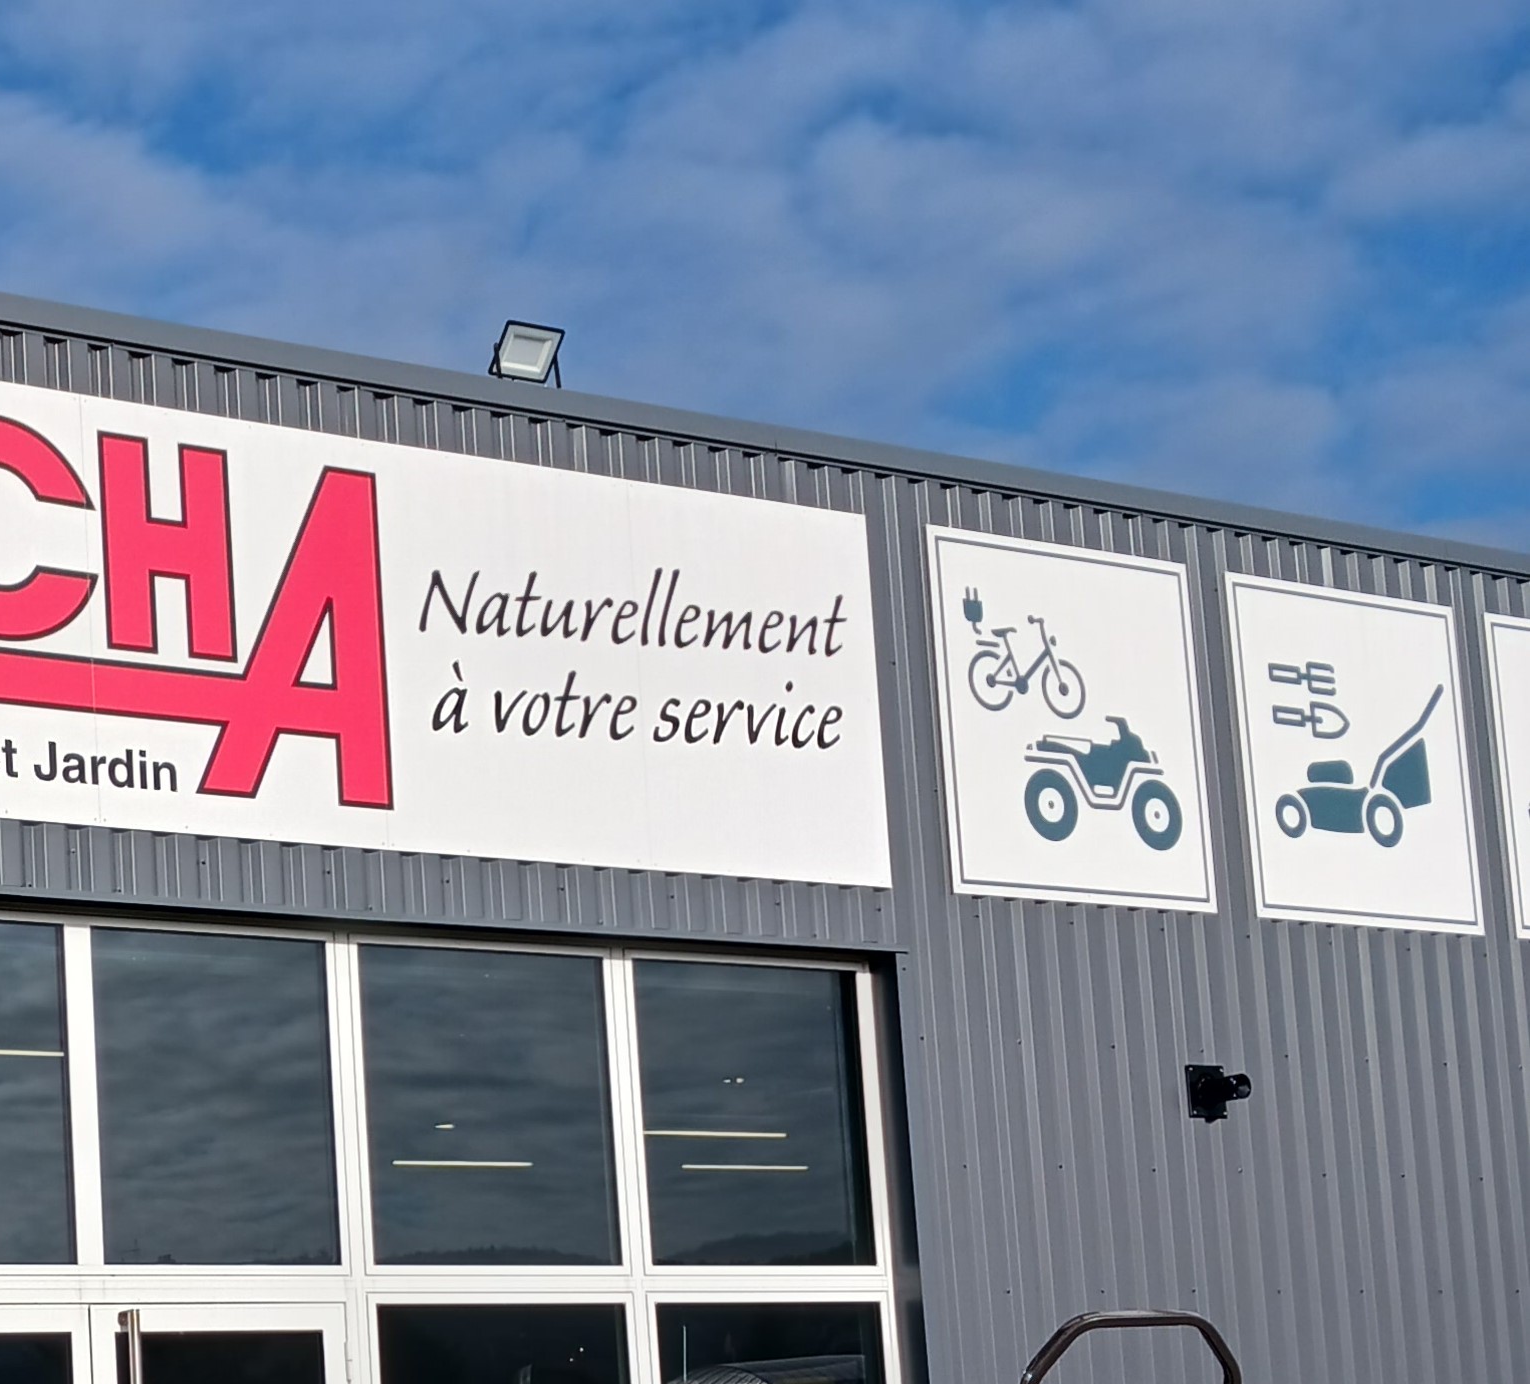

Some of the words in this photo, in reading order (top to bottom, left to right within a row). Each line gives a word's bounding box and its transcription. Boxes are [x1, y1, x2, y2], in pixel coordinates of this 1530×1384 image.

[418, 567, 848, 657] Naturellement
[431, 660, 469, 733] à
[493, 670, 638, 741] votre
[652, 680, 844, 749] service
[33, 739, 179, 793] Jardin
